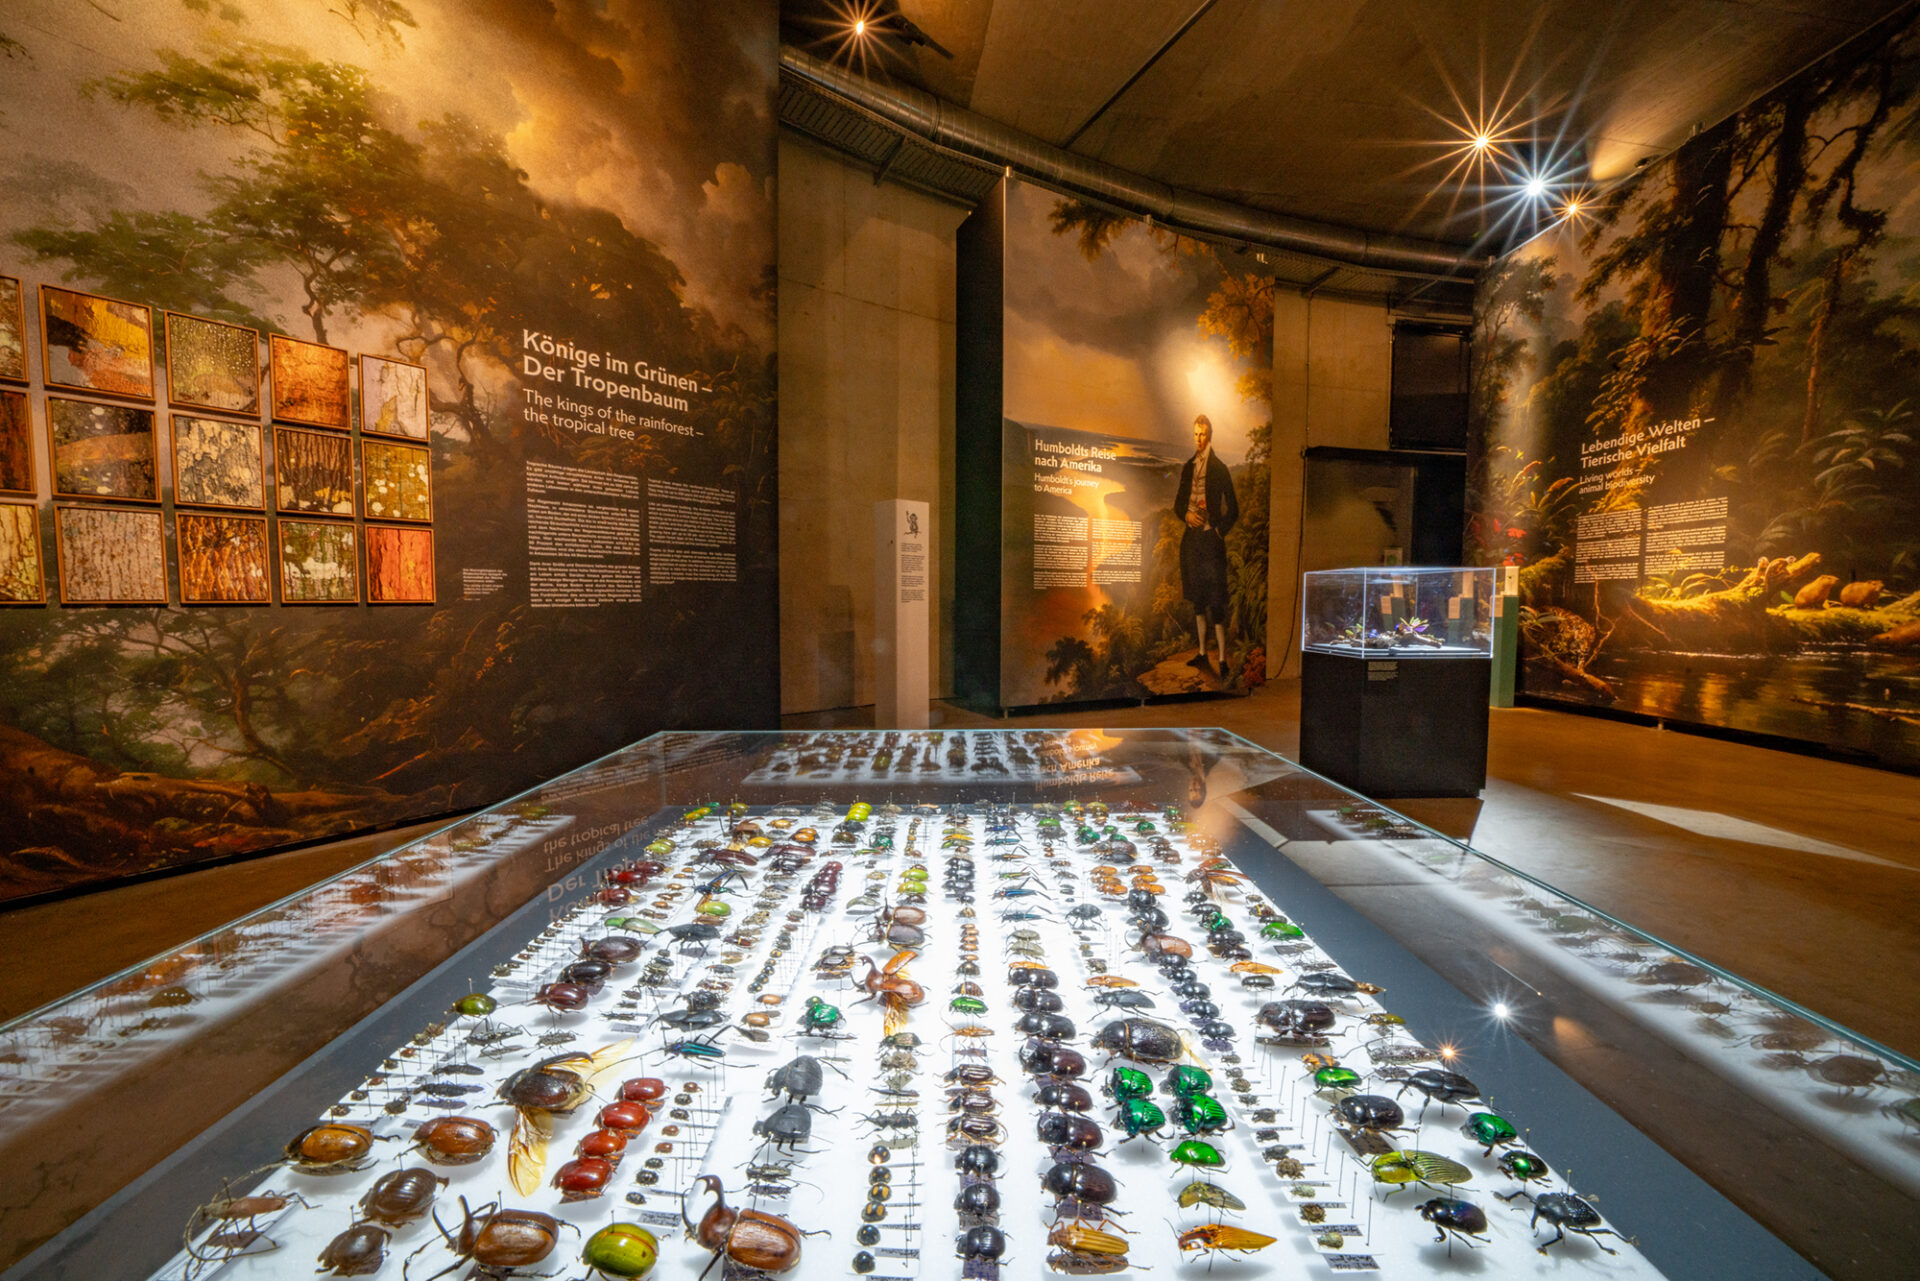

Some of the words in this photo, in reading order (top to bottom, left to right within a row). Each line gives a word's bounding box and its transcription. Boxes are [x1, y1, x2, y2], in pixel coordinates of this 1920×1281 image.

[523, 329, 600, 368] Könige
[606, 352, 628, 375] im
[634, 361, 698, 393] Grünen
[523, 355, 565, 383] Der
[571, 367, 689, 412] Tropenbaum
[523, 388, 553, 408] The
[557, 395, 594, 417] kings
[597, 407, 613, 419] of
[615, 409, 636, 425] the
[639, 416, 694, 437] rainforest
[523, 407, 549, 425] the
[552, 413, 605, 435] tropical
[609, 425, 635, 440] tree
[1034, 439, 1089, 457] Humboldts
[1090, 447, 1116, 461] Reise
[1581, 429, 1645, 455] Lebendige
[1648, 418, 1700, 438] Welten
[1034, 455, 1058, 467] nach
[1060, 458, 1102, 473] Amerika
[1580, 448, 1633, 469] Tierische
[1636, 435, 1686, 456] Vielfalt
[1034, 473, 1073, 486] Humboldt's
[1074, 478, 1099, 489] journey
[1034, 484, 1043, 492] to
[1043, 485, 1072, 495] America
[1579, 473, 1604, 485] Living
[1605, 467, 1633, 480] worlds
[1579, 482, 1603, 495] animal
[1605, 474, 1655, 490] biodiversity
